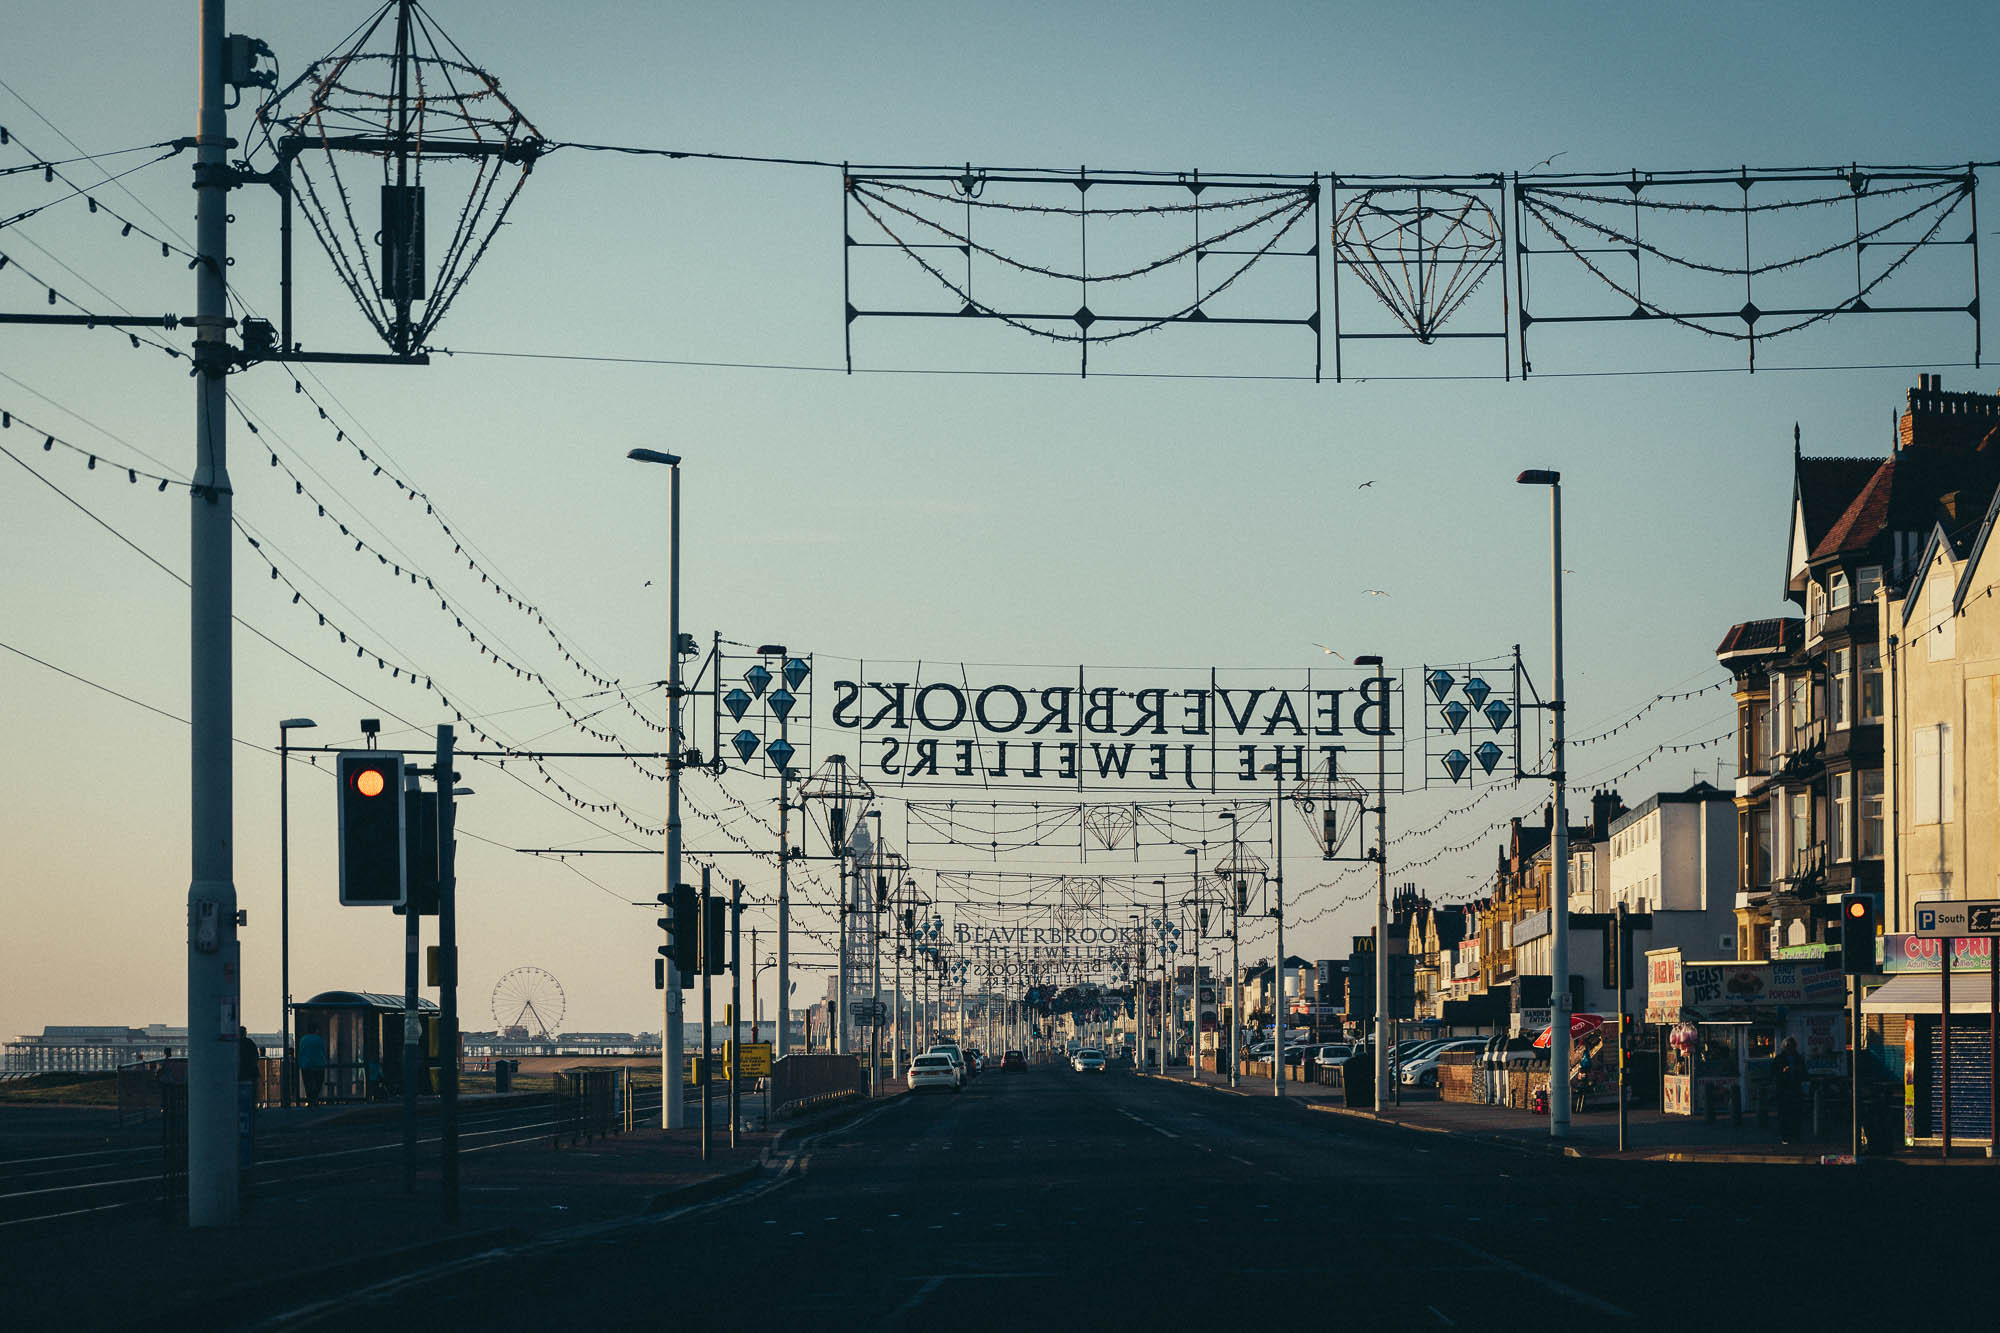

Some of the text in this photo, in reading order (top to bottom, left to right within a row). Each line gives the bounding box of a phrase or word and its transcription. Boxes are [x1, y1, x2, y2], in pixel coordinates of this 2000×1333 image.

[1938, 914, 1965, 924] South
[956, 922, 1145, 944] BEAVERBROOKS
[974, 946, 1129, 962] THE JEWELLERS
[1685, 967, 1723, 987] GREASY
[1775, 975, 1796, 985] FLOSS
[1694, 984, 1721, 1004] JOE'S
[1768, 989, 1801, 999] POPCORN
